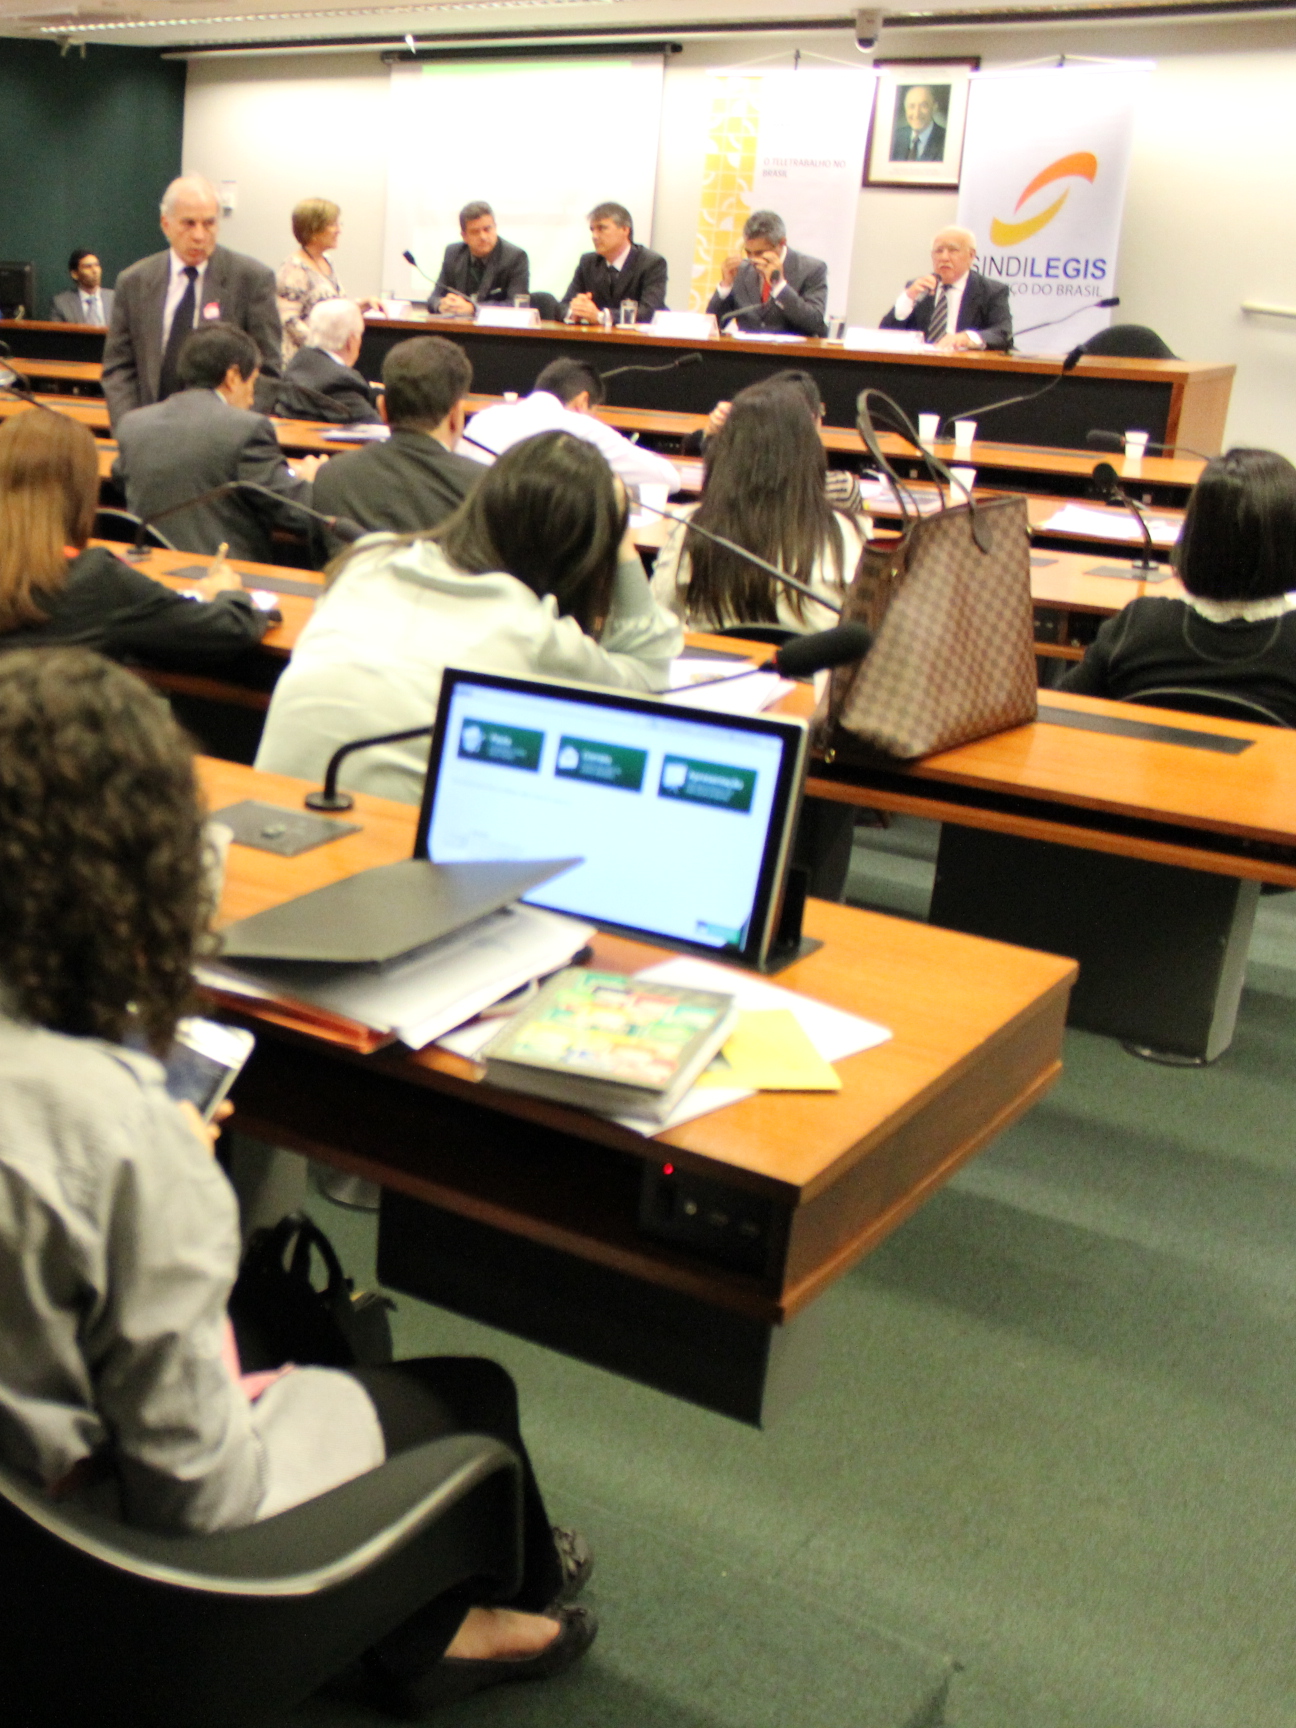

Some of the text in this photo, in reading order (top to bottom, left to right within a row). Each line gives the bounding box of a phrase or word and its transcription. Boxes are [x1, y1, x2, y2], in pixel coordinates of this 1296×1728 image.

[763, 157, 770, 166] O
[833, 159, 846, 168] NO
[762, 169, 787, 177] BRASIL
[1031, 283, 1053, 296] DO
[1056, 284, 1103, 297] BRASIL
